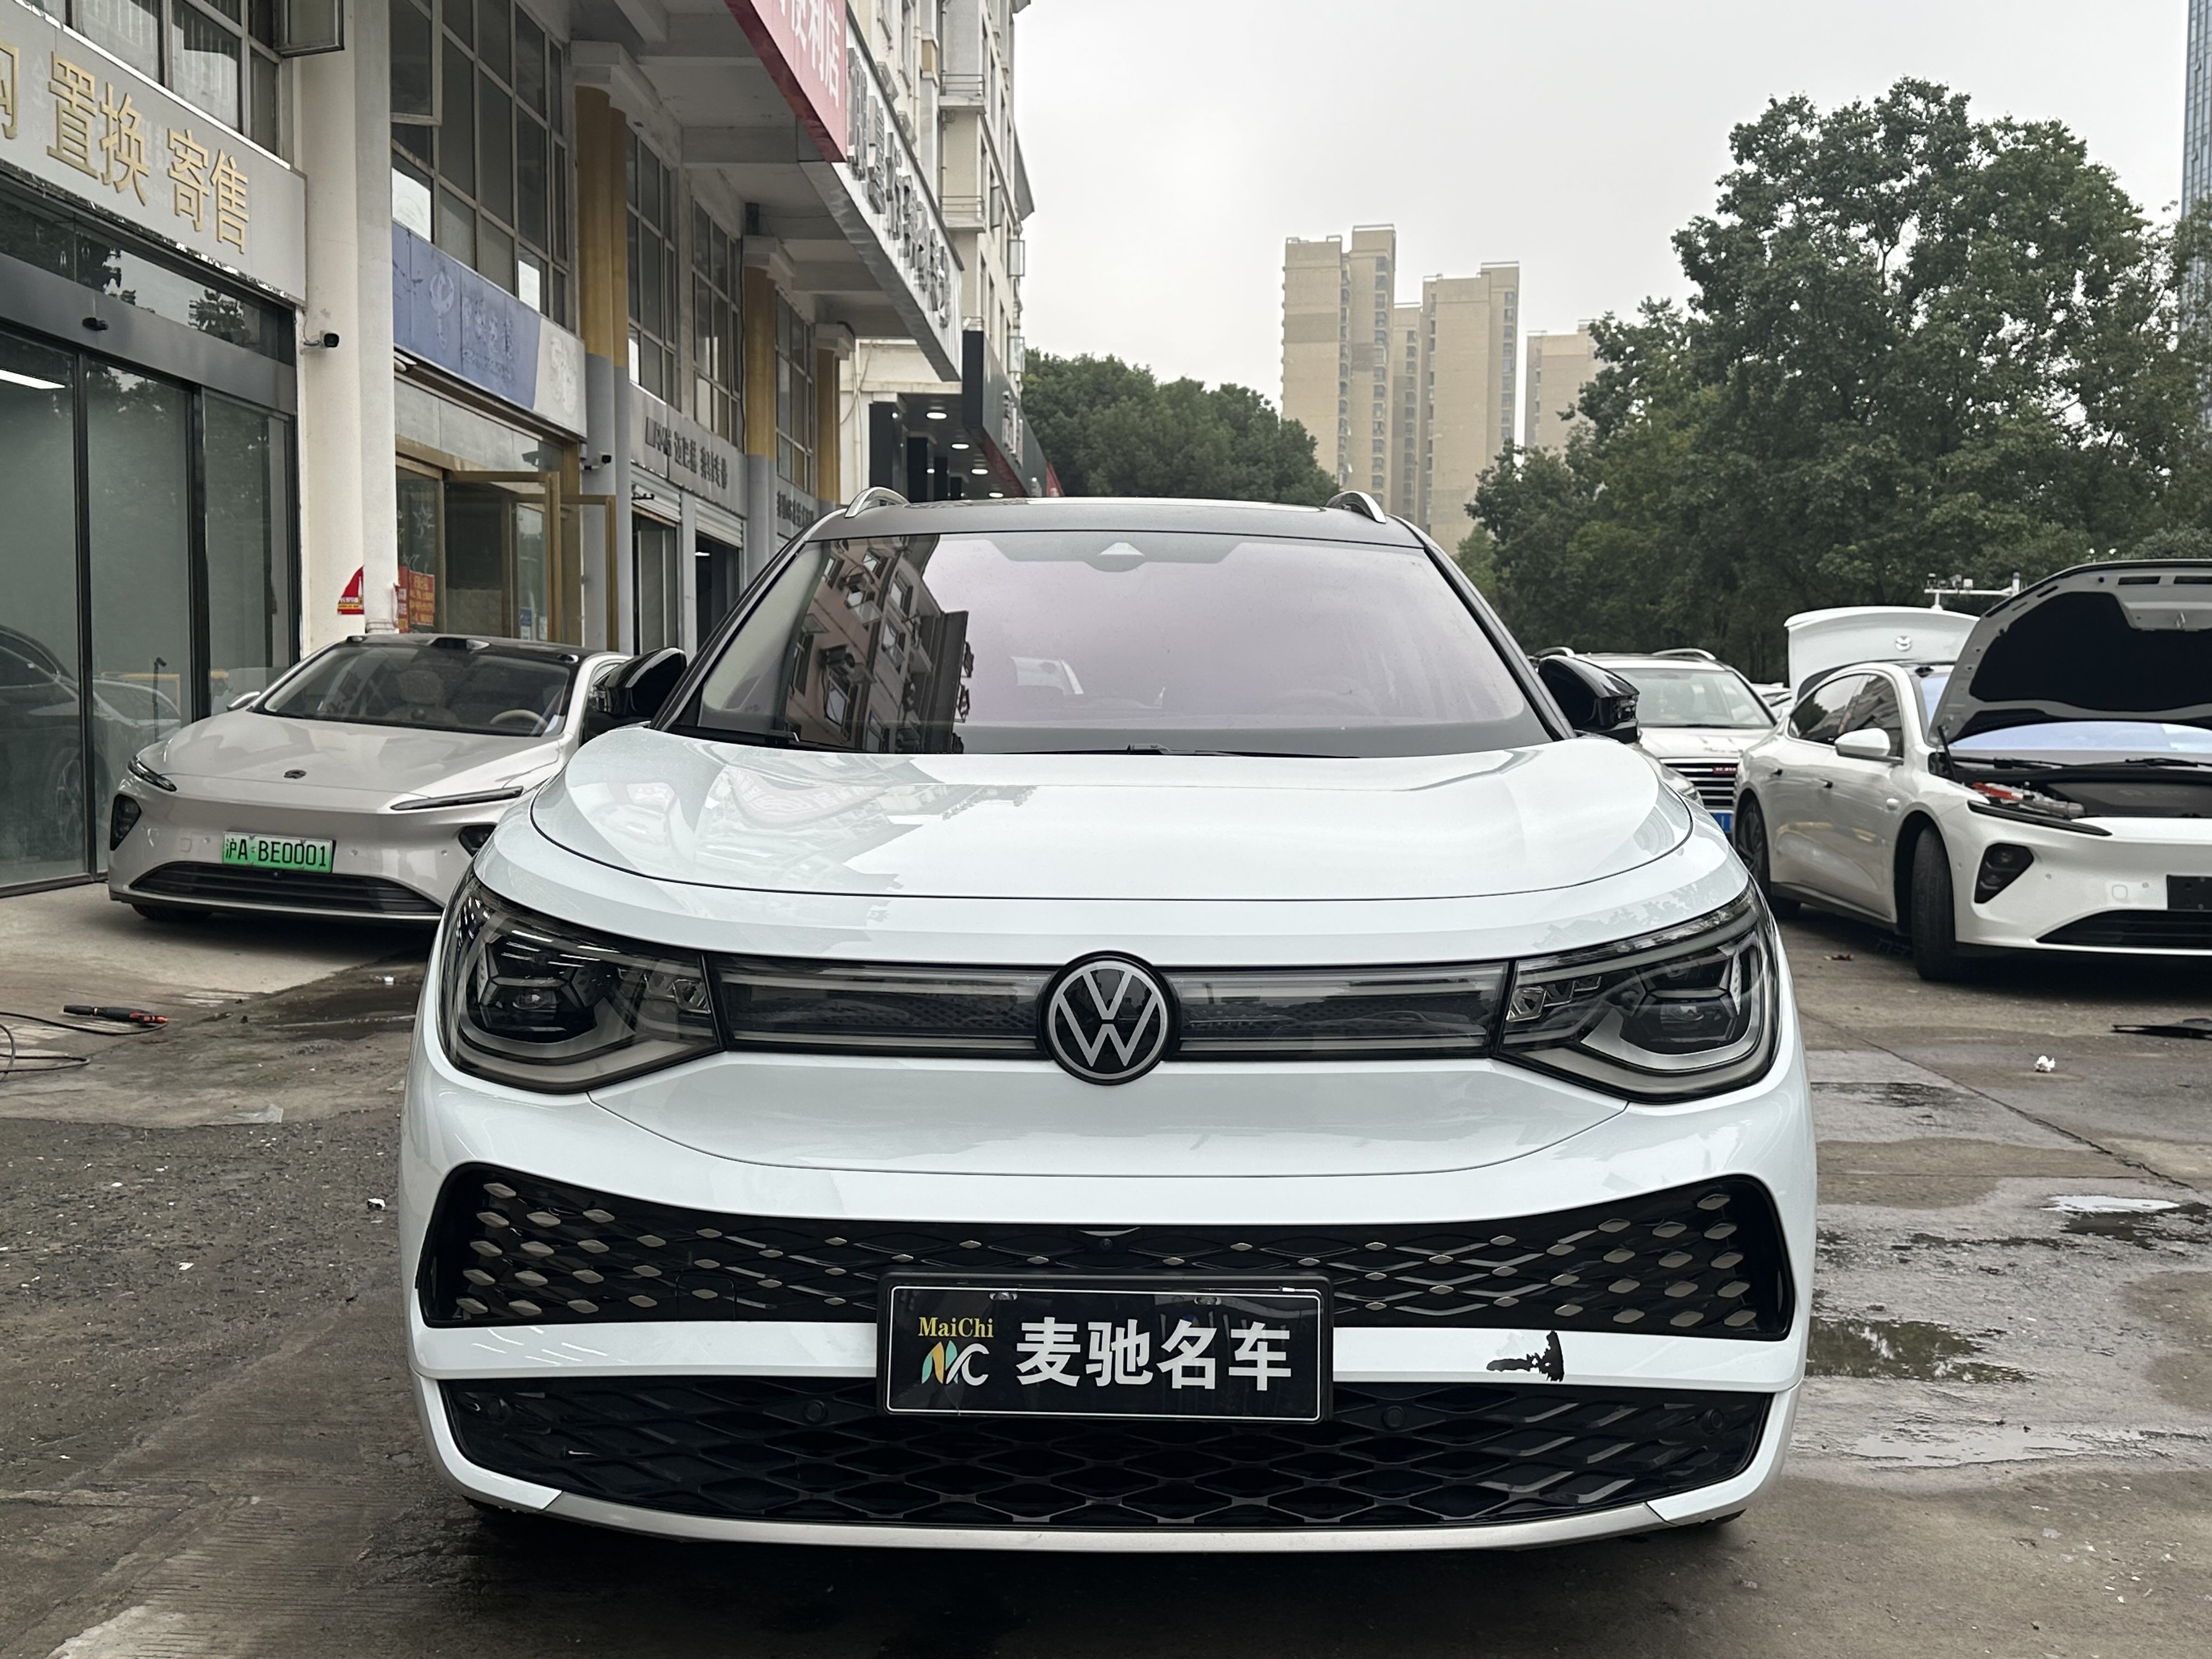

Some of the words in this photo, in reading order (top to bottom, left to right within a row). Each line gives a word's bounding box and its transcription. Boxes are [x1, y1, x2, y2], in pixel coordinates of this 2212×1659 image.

[47, 51, 149, 206] 置换
[167, 128, 249, 255] 寄售
[918, 1317, 994, 1338] MaiChi
[1015, 1317, 1292, 1391] 麦驰名车
